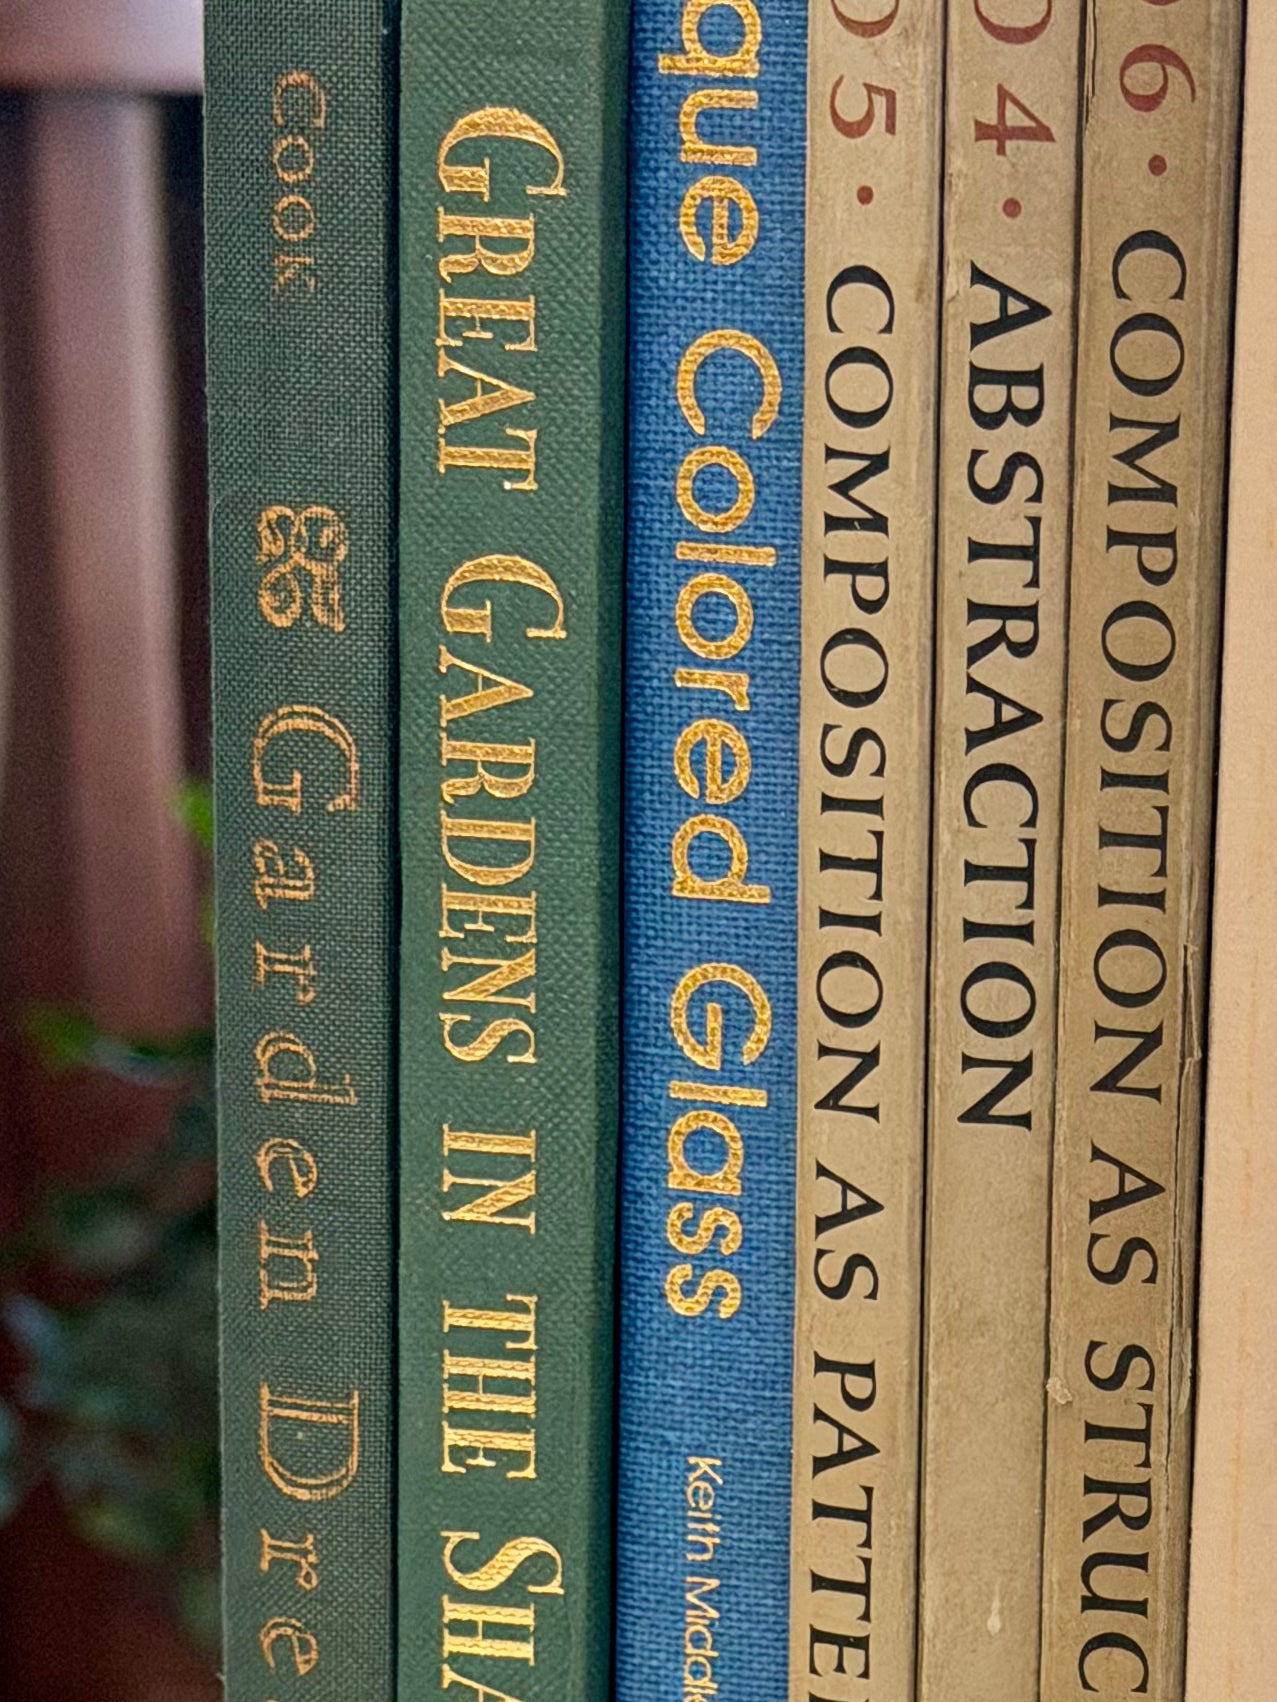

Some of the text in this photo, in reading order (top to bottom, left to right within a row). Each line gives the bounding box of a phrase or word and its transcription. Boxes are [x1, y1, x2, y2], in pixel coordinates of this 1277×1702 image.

[829, 74, 897, 139] 5
[974, 83, 1056, 157] 4
[1119, 44, 1196, 113] 6
[436, 104, 567, 491] GREAT
[670, 328, 783, 905] Colored
[813, 264, 896, 1125] COMPOSITION
[956, 260, 1053, 1132] ABSTRACTION
[1089, 230, 1188, 1105] COMPOSITION
[437, 553, 567, 1064] GARDENS
[252, 705, 359, 1310] Garden
[663, 961, 773, 1320] Glass
[440, 1122, 537, 1235] IN
[813, 1159, 886, 1303] AS
[1086, 1139, 1166, 1287] AS
[441, 1293, 539, 1480] THE
[684, 1456, 724, 1562] Keith
